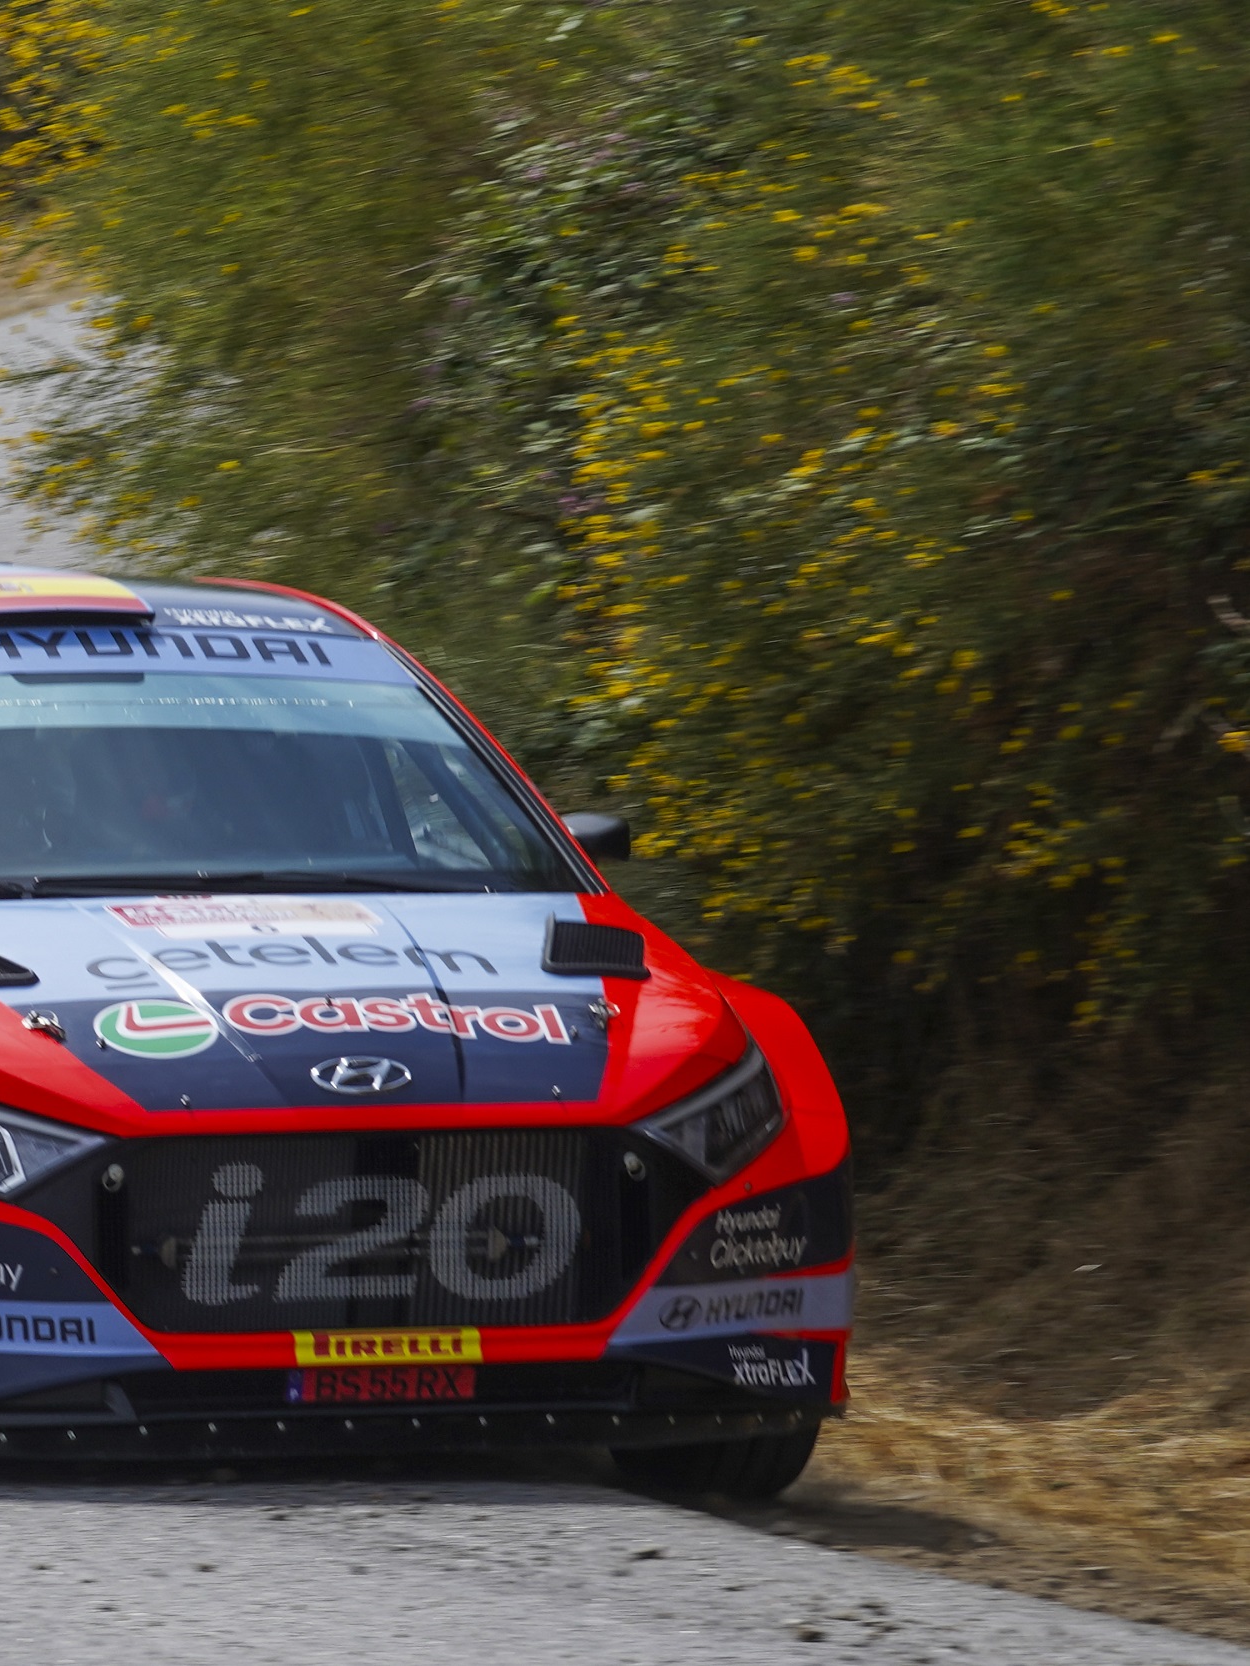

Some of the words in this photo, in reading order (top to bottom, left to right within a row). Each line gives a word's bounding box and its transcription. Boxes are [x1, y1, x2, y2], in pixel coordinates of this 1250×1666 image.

[86, 936, 498, 990] cetelem
[222, 992, 572, 1046] Castrol
[181, 1162, 581, 1305] i20
[706, 1288, 804, 1325] HYUNDAI
[312, 1327, 463, 1358] PIRELLI
